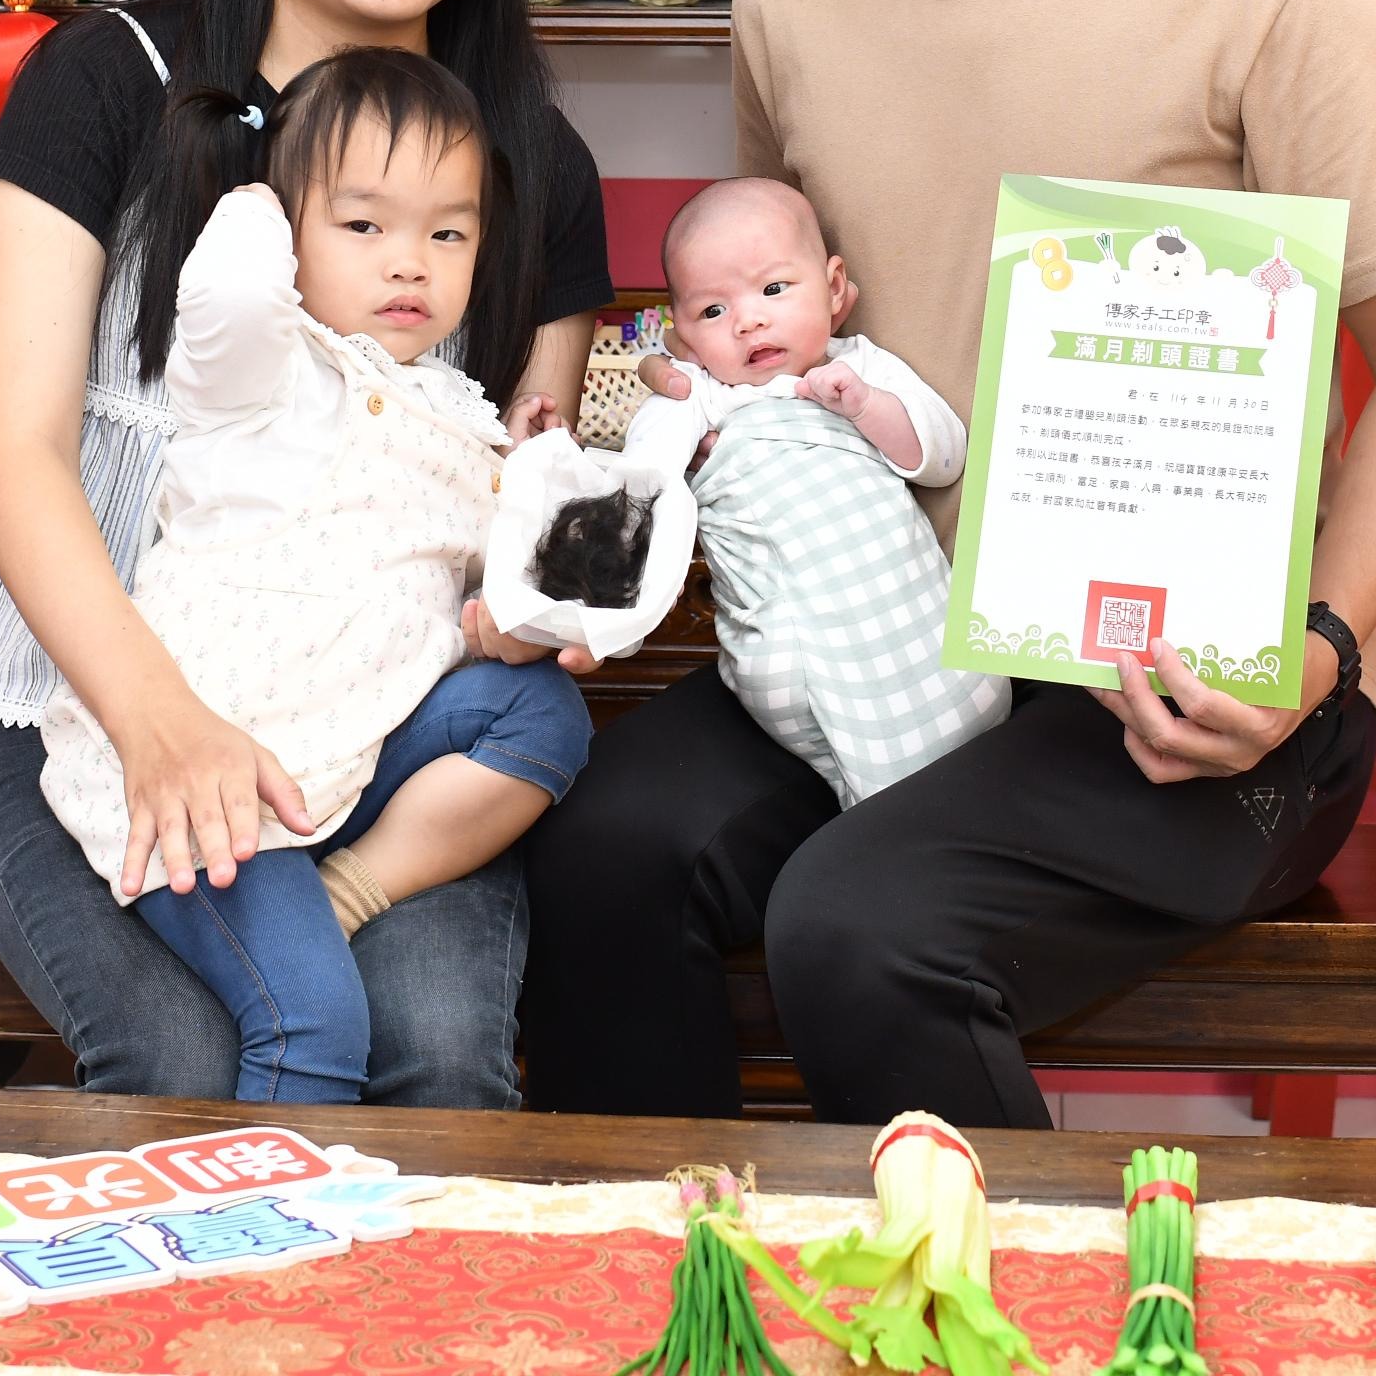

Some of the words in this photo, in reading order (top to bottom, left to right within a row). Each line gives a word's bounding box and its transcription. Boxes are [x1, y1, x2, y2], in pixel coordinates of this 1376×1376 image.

[1105, 302, 1212, 325] 傳家手工印章
[1105, 321, 1208, 336] www.seals.com.tw
[1075, 335, 1240, 372] 滿月剃頭證書
